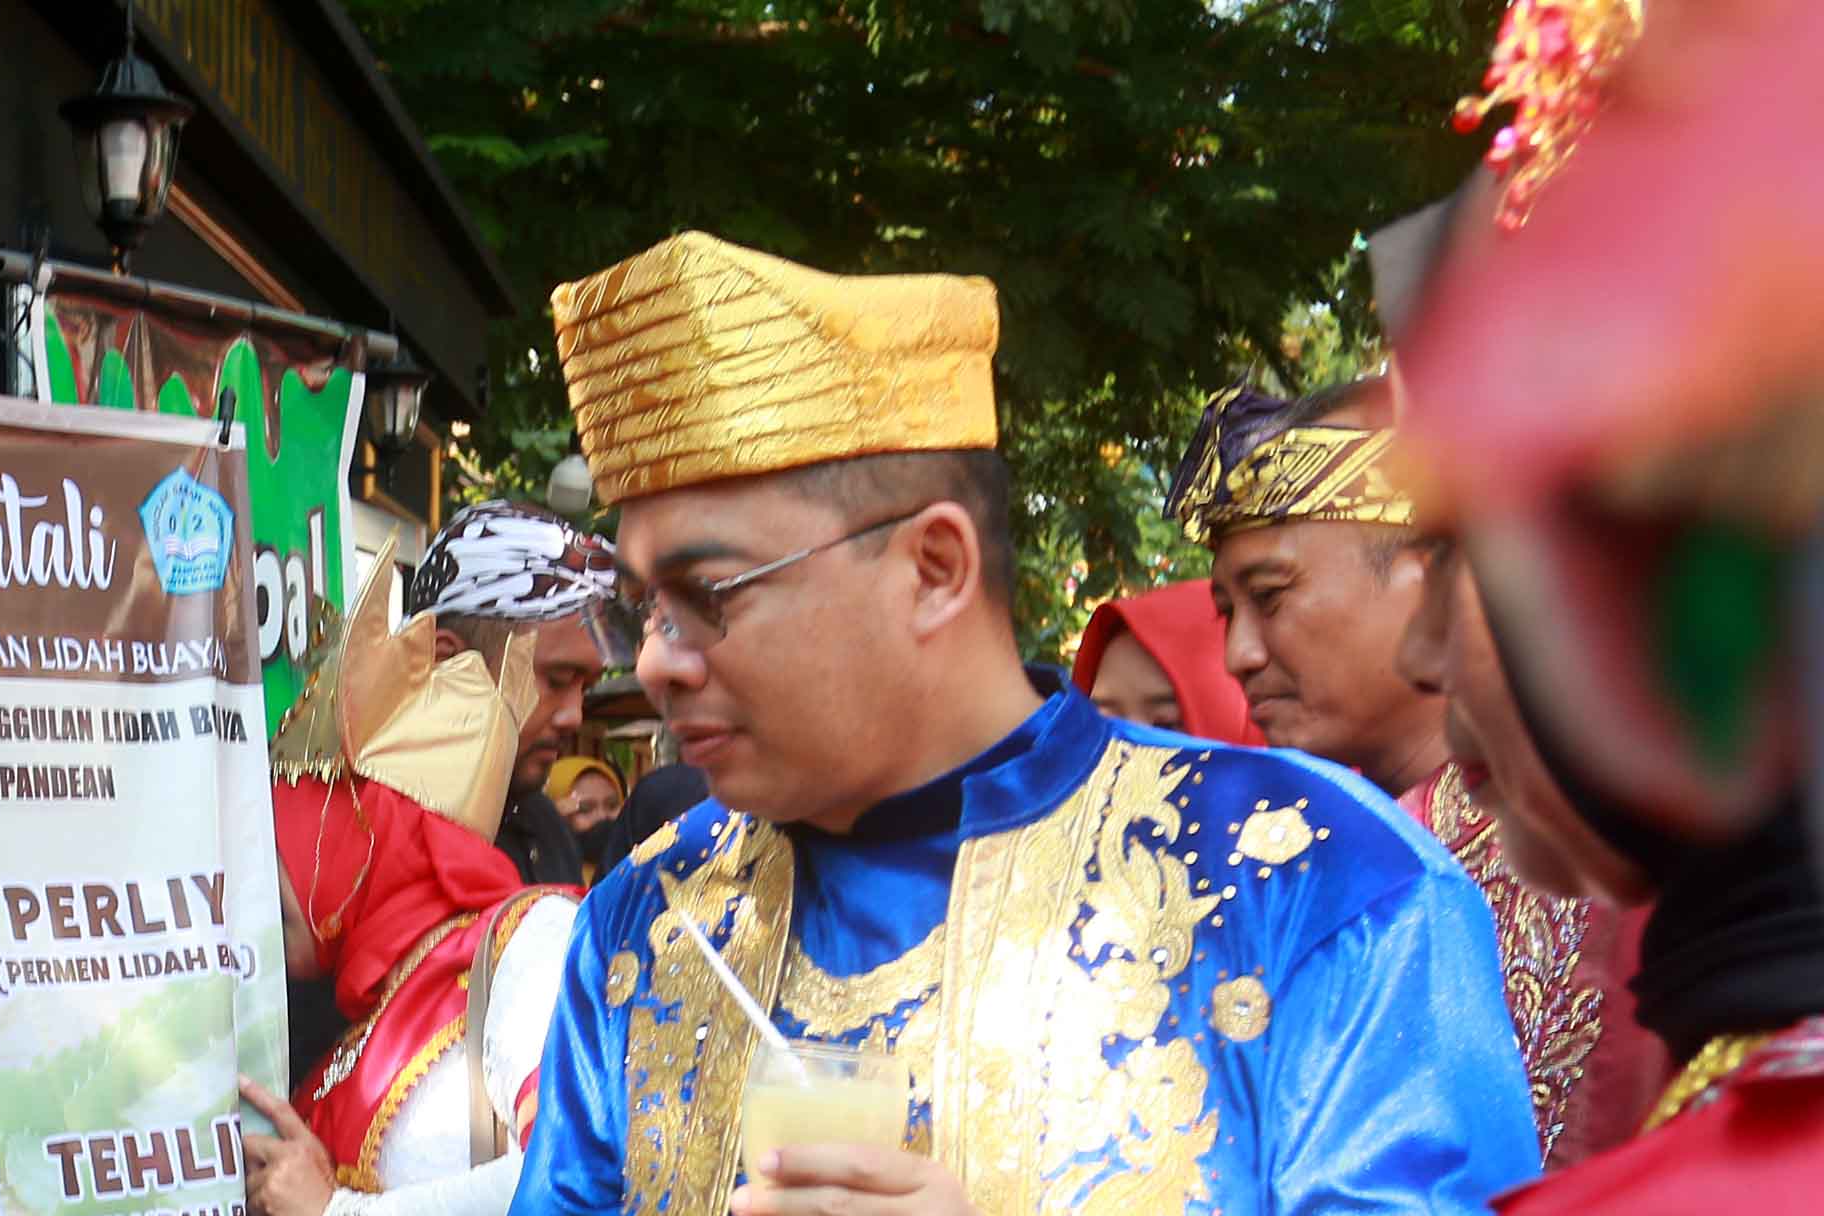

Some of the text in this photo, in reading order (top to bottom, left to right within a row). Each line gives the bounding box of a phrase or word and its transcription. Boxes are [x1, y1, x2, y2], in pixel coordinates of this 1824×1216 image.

[37, 635, 126, 673] LIDAH
[100, 707, 181, 743] LIDAH
[0, 764, 117, 800] PANDEAN
[118, 946, 208, 980] LIDAH
